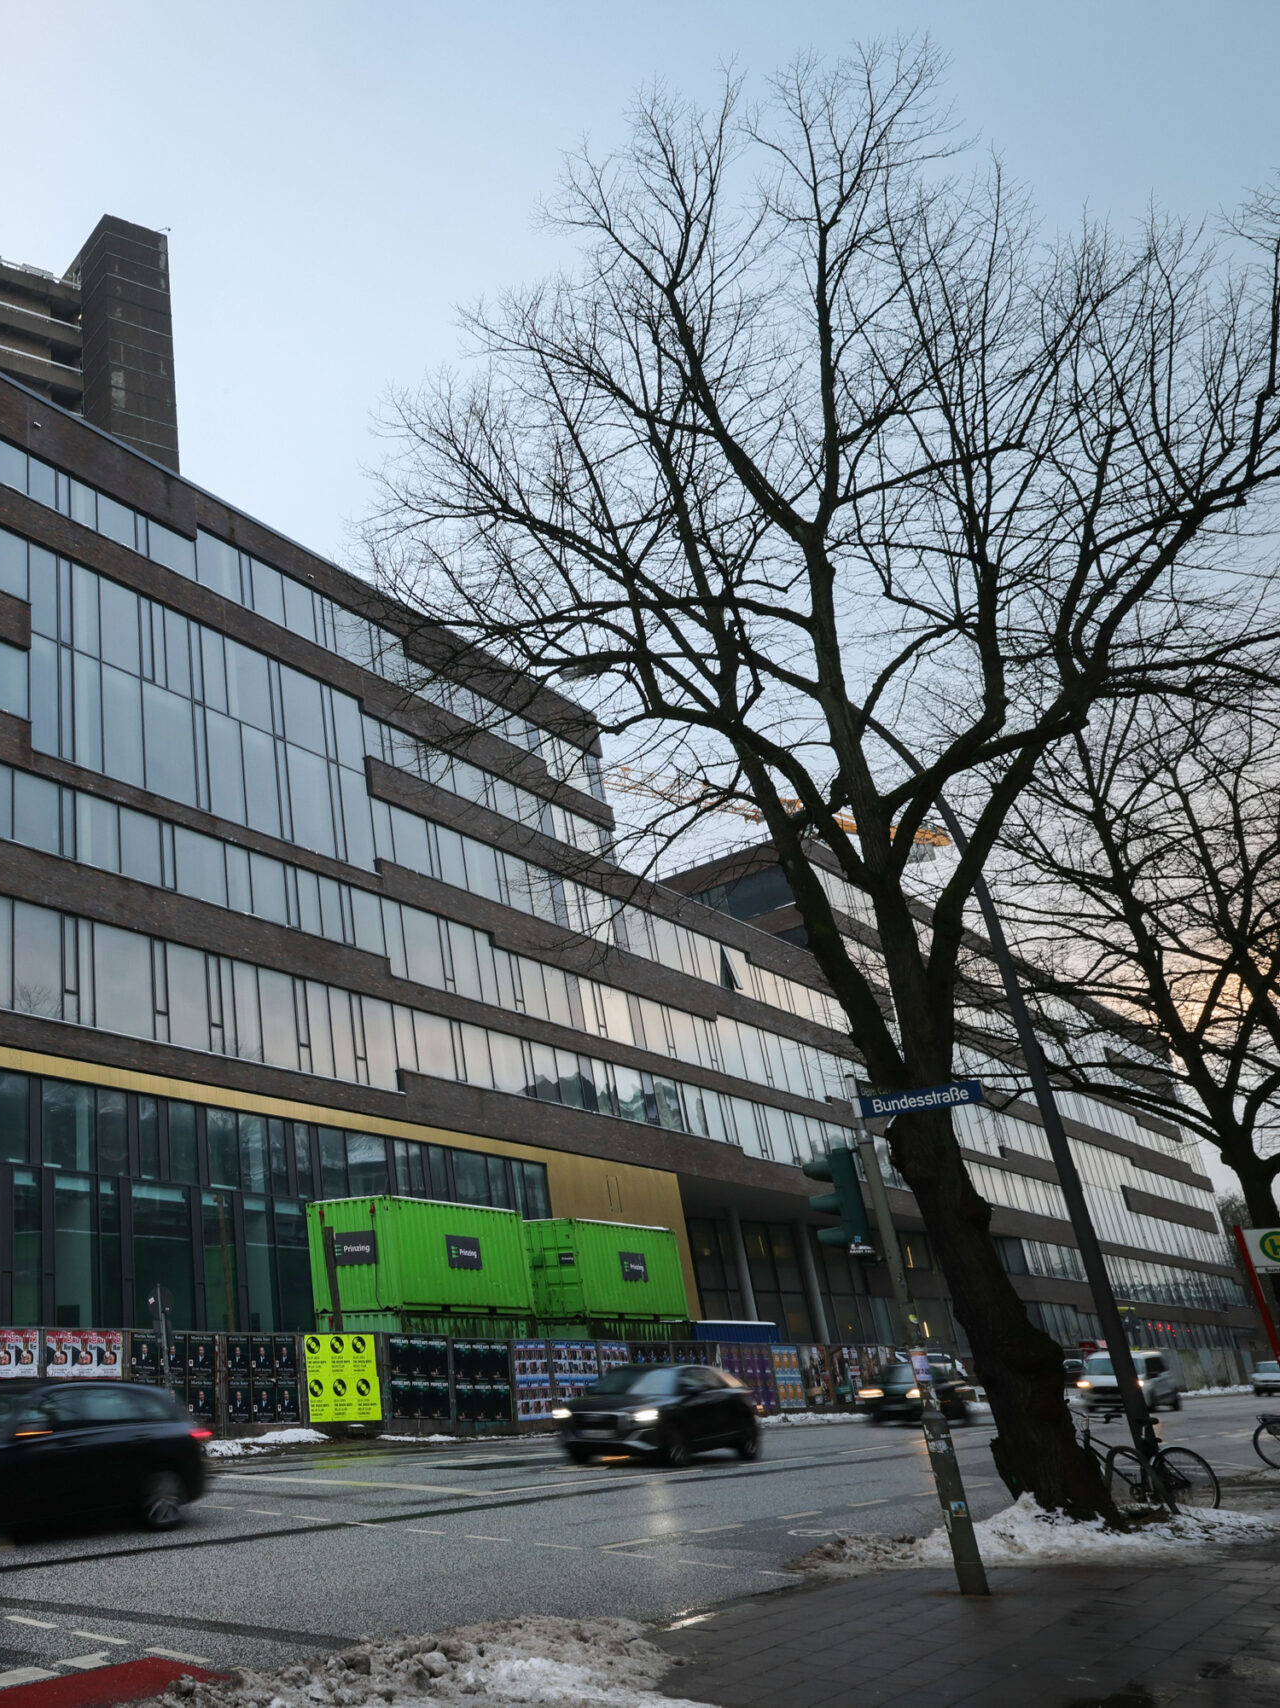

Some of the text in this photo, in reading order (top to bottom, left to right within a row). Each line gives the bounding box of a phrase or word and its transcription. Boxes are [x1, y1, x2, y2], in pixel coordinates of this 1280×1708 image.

[872, 1086, 969, 1113] Bundesstraße
[343, 1244, 370, 1253] Prinzing
[459, 1248, 477, 1259] Prinzing
